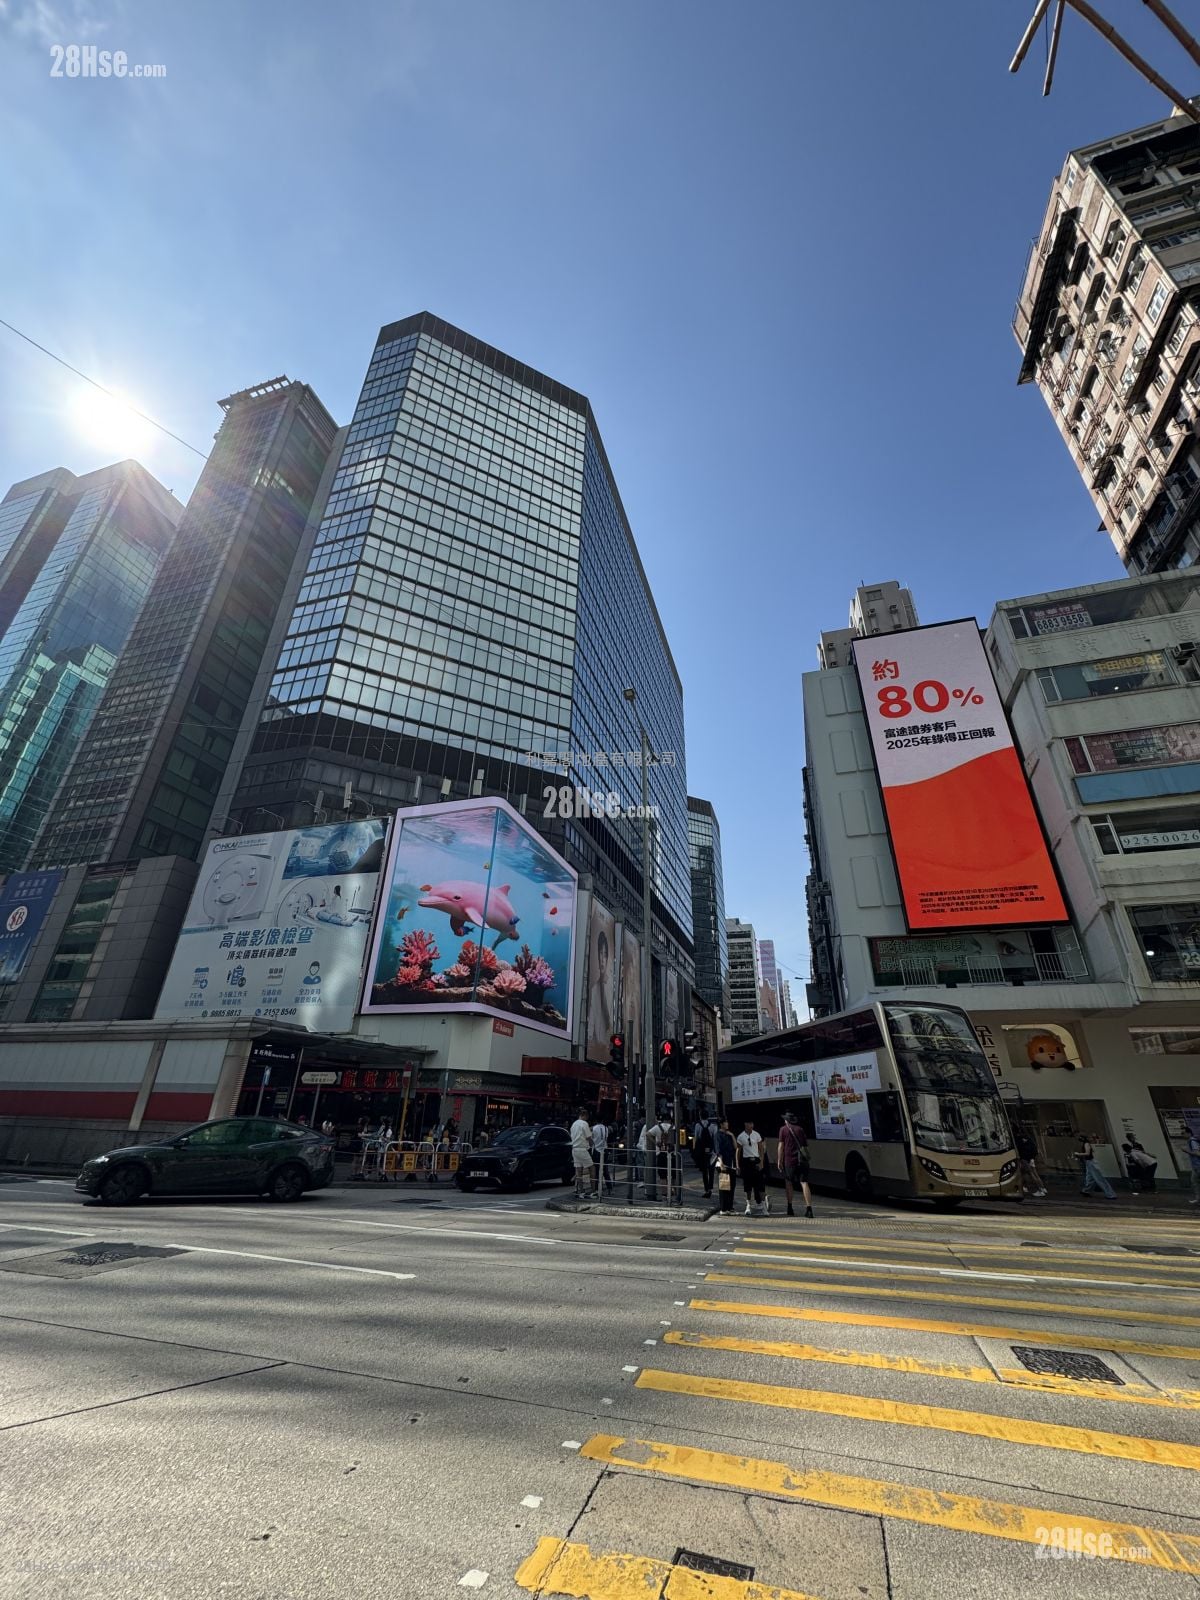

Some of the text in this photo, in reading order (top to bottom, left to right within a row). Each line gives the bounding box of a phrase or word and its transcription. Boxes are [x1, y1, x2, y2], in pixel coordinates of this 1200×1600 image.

[1060, 613, 1085, 626] 9558
[871, 659, 900, 681] 約
[877, 680, 984, 719] 80%
[884, 720, 957, 739] 富途證券客戶
[886, 727, 997, 750] 2025年錄得正回報
[219, 927, 315, 949] 高端影像檢查
